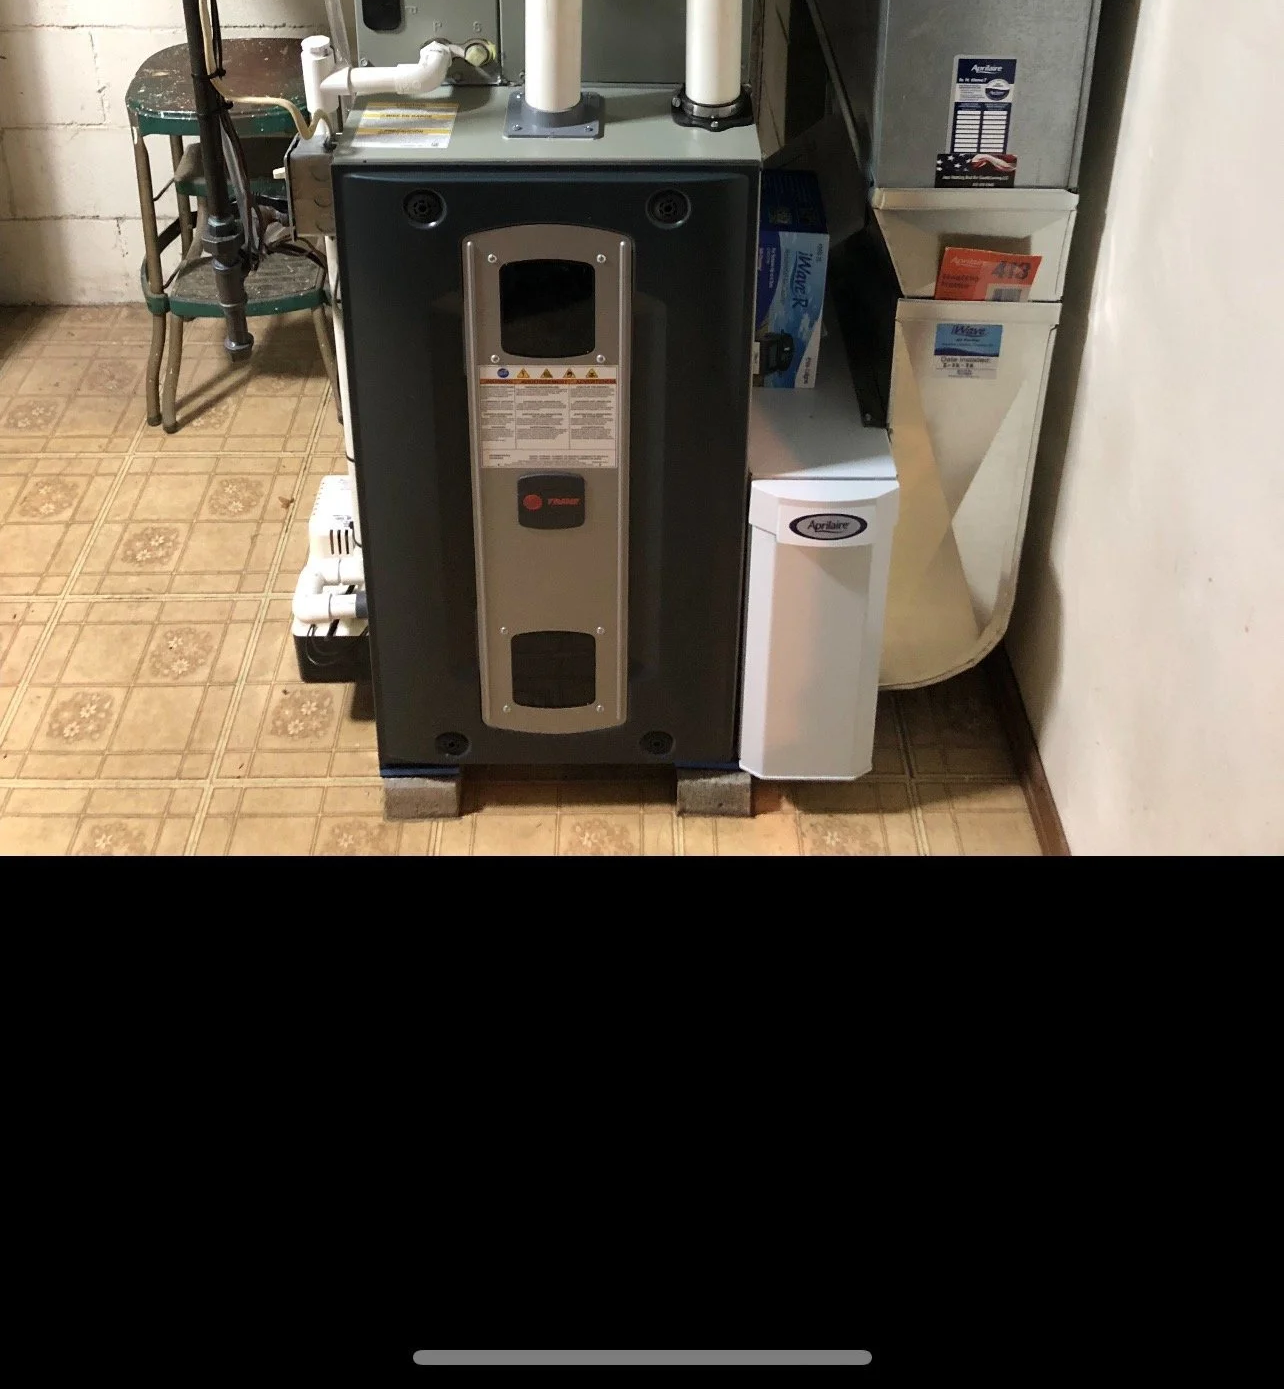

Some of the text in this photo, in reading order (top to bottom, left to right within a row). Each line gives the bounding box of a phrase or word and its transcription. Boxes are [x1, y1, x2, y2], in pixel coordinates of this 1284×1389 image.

[970, 64, 1003, 75] Aprilaire
[991, 260, 1031, 280] 413
[951, 324, 986, 337] iWave
[547, 497, 582, 506] TRANE
[807, 519, 850, 534] Aprilaire
